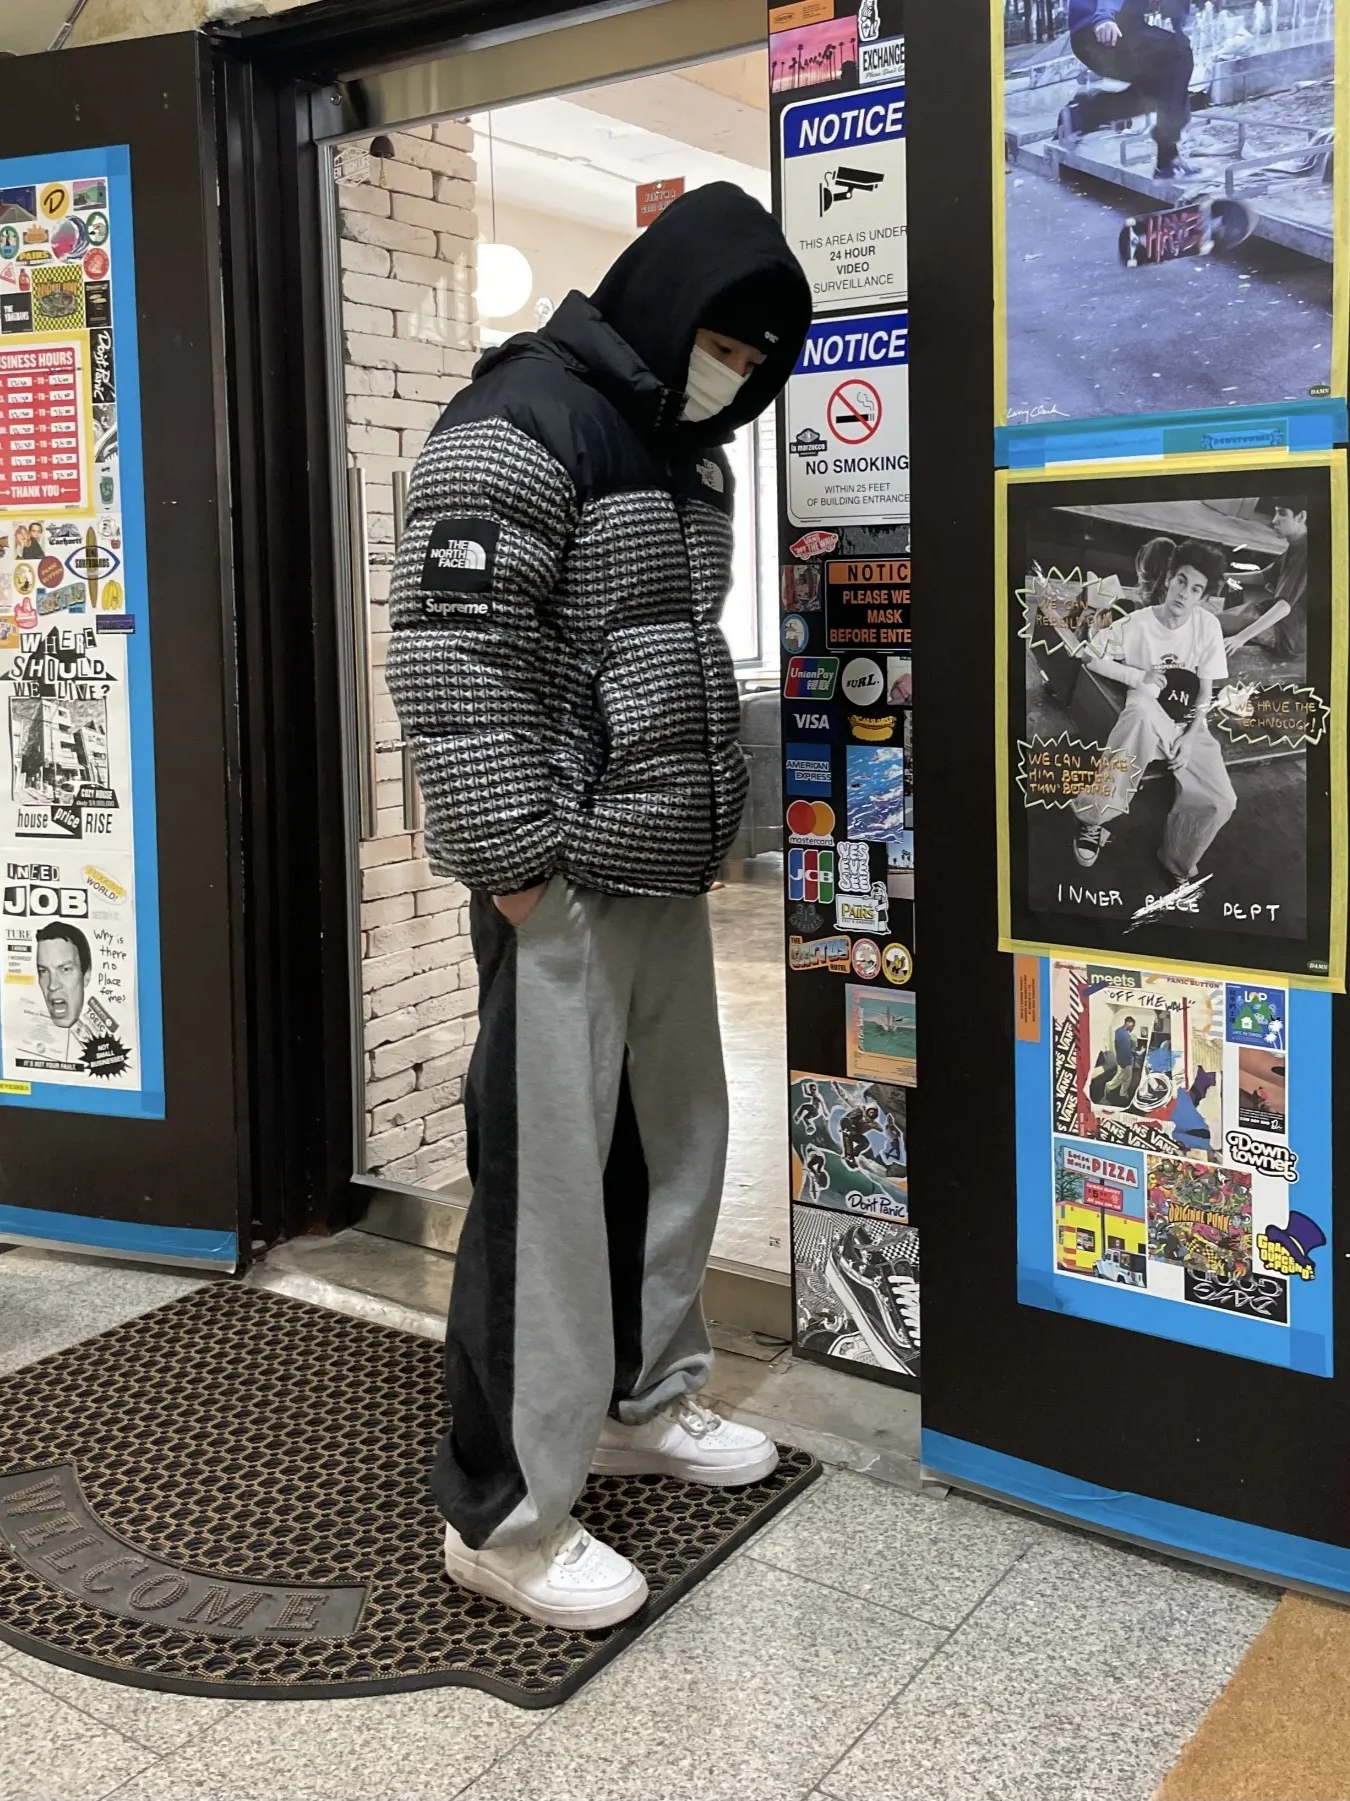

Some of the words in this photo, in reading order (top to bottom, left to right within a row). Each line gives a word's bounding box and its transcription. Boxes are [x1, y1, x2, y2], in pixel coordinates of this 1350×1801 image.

[799, 101, 905, 149] NOTICE
[799, 238, 823, 251] THIS
[825, 232, 854, 247] AREA
[856, 231, 866, 242] IS
[869, 225, 908, 241] UNDER
[829, 251, 842, 261] 24
[844, 245, 876, 260] HOUR
[836, 261, 870, 276] VIDEO
[813, 273, 894, 294] SURVEILLANCE
[802, 328, 908, 367] NOTICE
[38, 351, 73, 367] HOURS
[1310, 388, 1329, 396] DAMN
[805, 459, 828, 475] NO
[833, 455, 909, 474] SMOKING
[11, 486, 40, 498] THANK
[41, 485, 60, 497] YOU
[824, 485, 855, 494] WITHIN
[856, 484, 867, 493] 25
[868, 483, 891, 492] FEET
[806, 498, 818, 507] OF
[820, 496, 861, 506] BUILDING
[448, 540, 469, 549] THE
[430, 549, 467, 559] NORTH
[438, 559, 466, 568] FACE
[842, 590, 889, 605] PLEASE
[425, 599, 488, 616] Supreme
[867, 609, 903, 624] MASK
[20, 627, 97, 654] WHERE
[829, 628, 877, 643] BEFORE
[11, 656, 105, 684] SHOULD
[790, 667, 834, 680] UnionPay
[13, 682, 40, 697] WE
[1235, 701, 1253, 713] WE
[1258, 700, 1289, 713] HAVE
[1295, 701, 1317, 713] THE
[792, 713, 830, 729] VISA
[786, 760, 829, 770] AMERICAN
[1028, 752, 1049, 766] WE
[1054, 753, 1081, 768] CAN
[1090, 755, 1128, 772] MAKE
[795, 771, 831, 781] EXPRESS
[1029, 768, 1055, 782] HIM
[17, 809, 49, 829] house
[53, 807, 80, 829] price
[85, 813, 113, 834] RISE
[790, 836, 834, 846] mastercard
[15, 864, 60, 881] NEED
[789, 867, 834, 883] JCB
[86, 877, 119, 902] WORLD!
[1058, 883, 1123, 906] INNER
[4, 886, 88, 916] JOB
[841, 902, 876, 919] PAIRS
[1223, 902, 1280, 922] DEPT
[94, 929, 113, 945] Why
[117, 934, 124, 944] is
[100, 945, 127, 960] there
[103, 961, 117, 970] no
[1090, 973, 1136, 988] meets
[1166, 978, 1188, 986] PANIC
[1190, 981, 1220, 989] BUTTON
[100, 986, 113, 996] for
[1138, 994, 1166, 1008] THE
[86, 1007, 105, 1033] TOEIC
[97, 1043, 109, 1051] NOT
[1092, 1158, 1136, 1184] PIZZA
[847, 1193, 878, 1212] Don't
[2, 1474, 330, 1632] WELCOME
